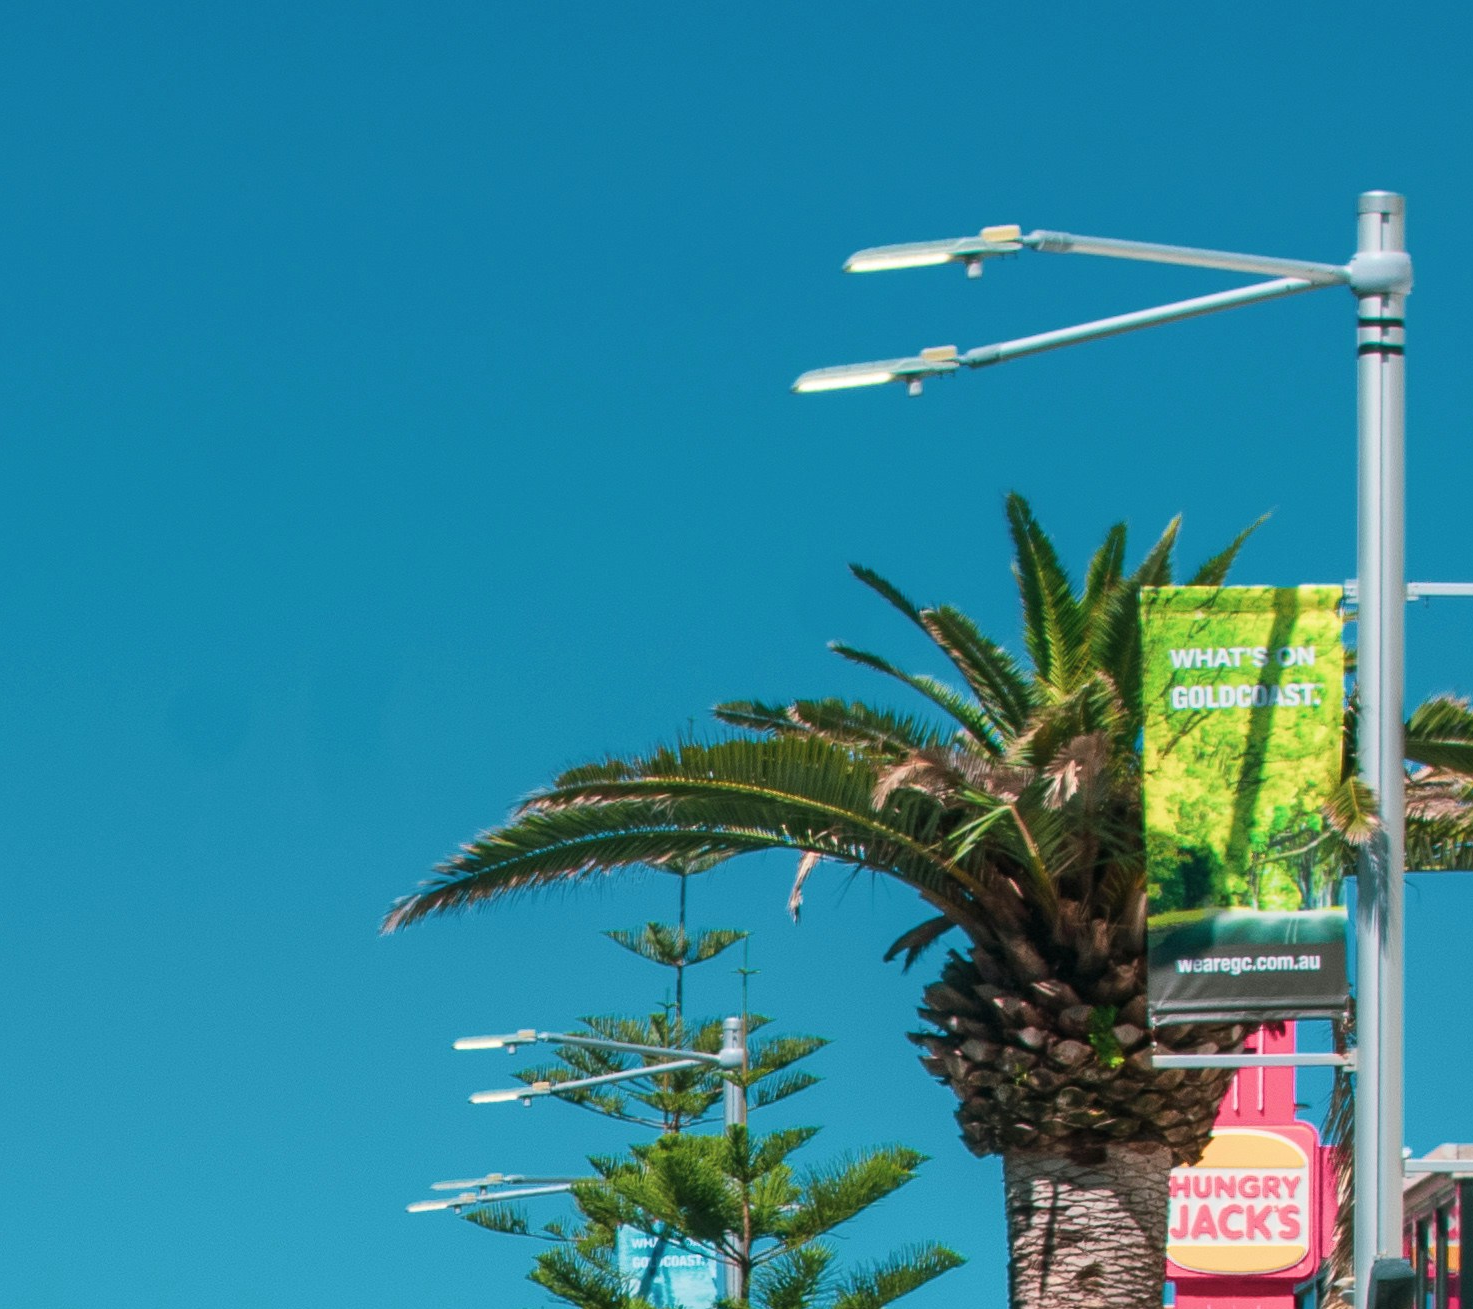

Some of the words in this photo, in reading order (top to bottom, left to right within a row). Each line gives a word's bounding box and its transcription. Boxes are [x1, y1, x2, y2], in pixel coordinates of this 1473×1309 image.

[1169, 646, 1269, 669] WHAT'S
[1277, 646, 1315, 667] ON
[1177, 955, 1321, 976] wearegc.com.au
[1168, 1175, 1301, 1199] HUNGRY
[1168, 1204, 1301, 1240] JACK'S
